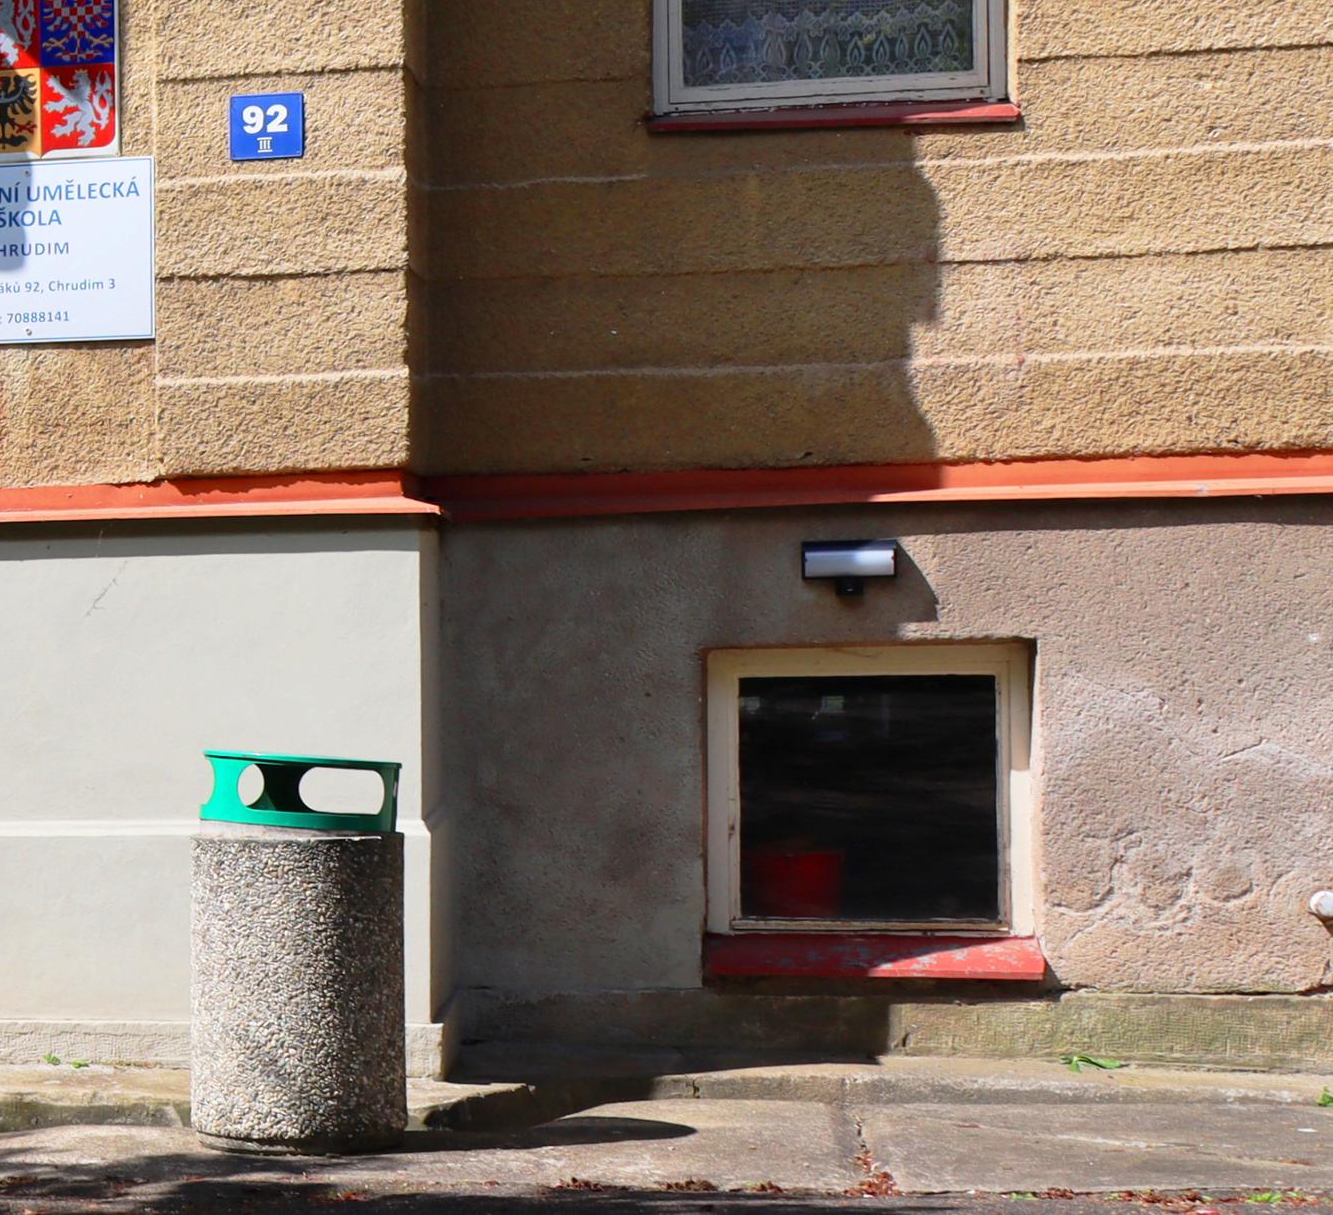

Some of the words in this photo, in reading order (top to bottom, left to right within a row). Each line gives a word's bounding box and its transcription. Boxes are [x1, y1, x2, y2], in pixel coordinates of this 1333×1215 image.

[242, 104, 288, 134] 92
[256, 137, 273, 153] III
[26, 176, 140, 202] UMĚLECKÁ
[24, 281, 44, 294] 92,
[48, 279, 104, 292] Chrudim
[108, 278, 116, 289] 3
[7, 311, 70, 324] 70888141
